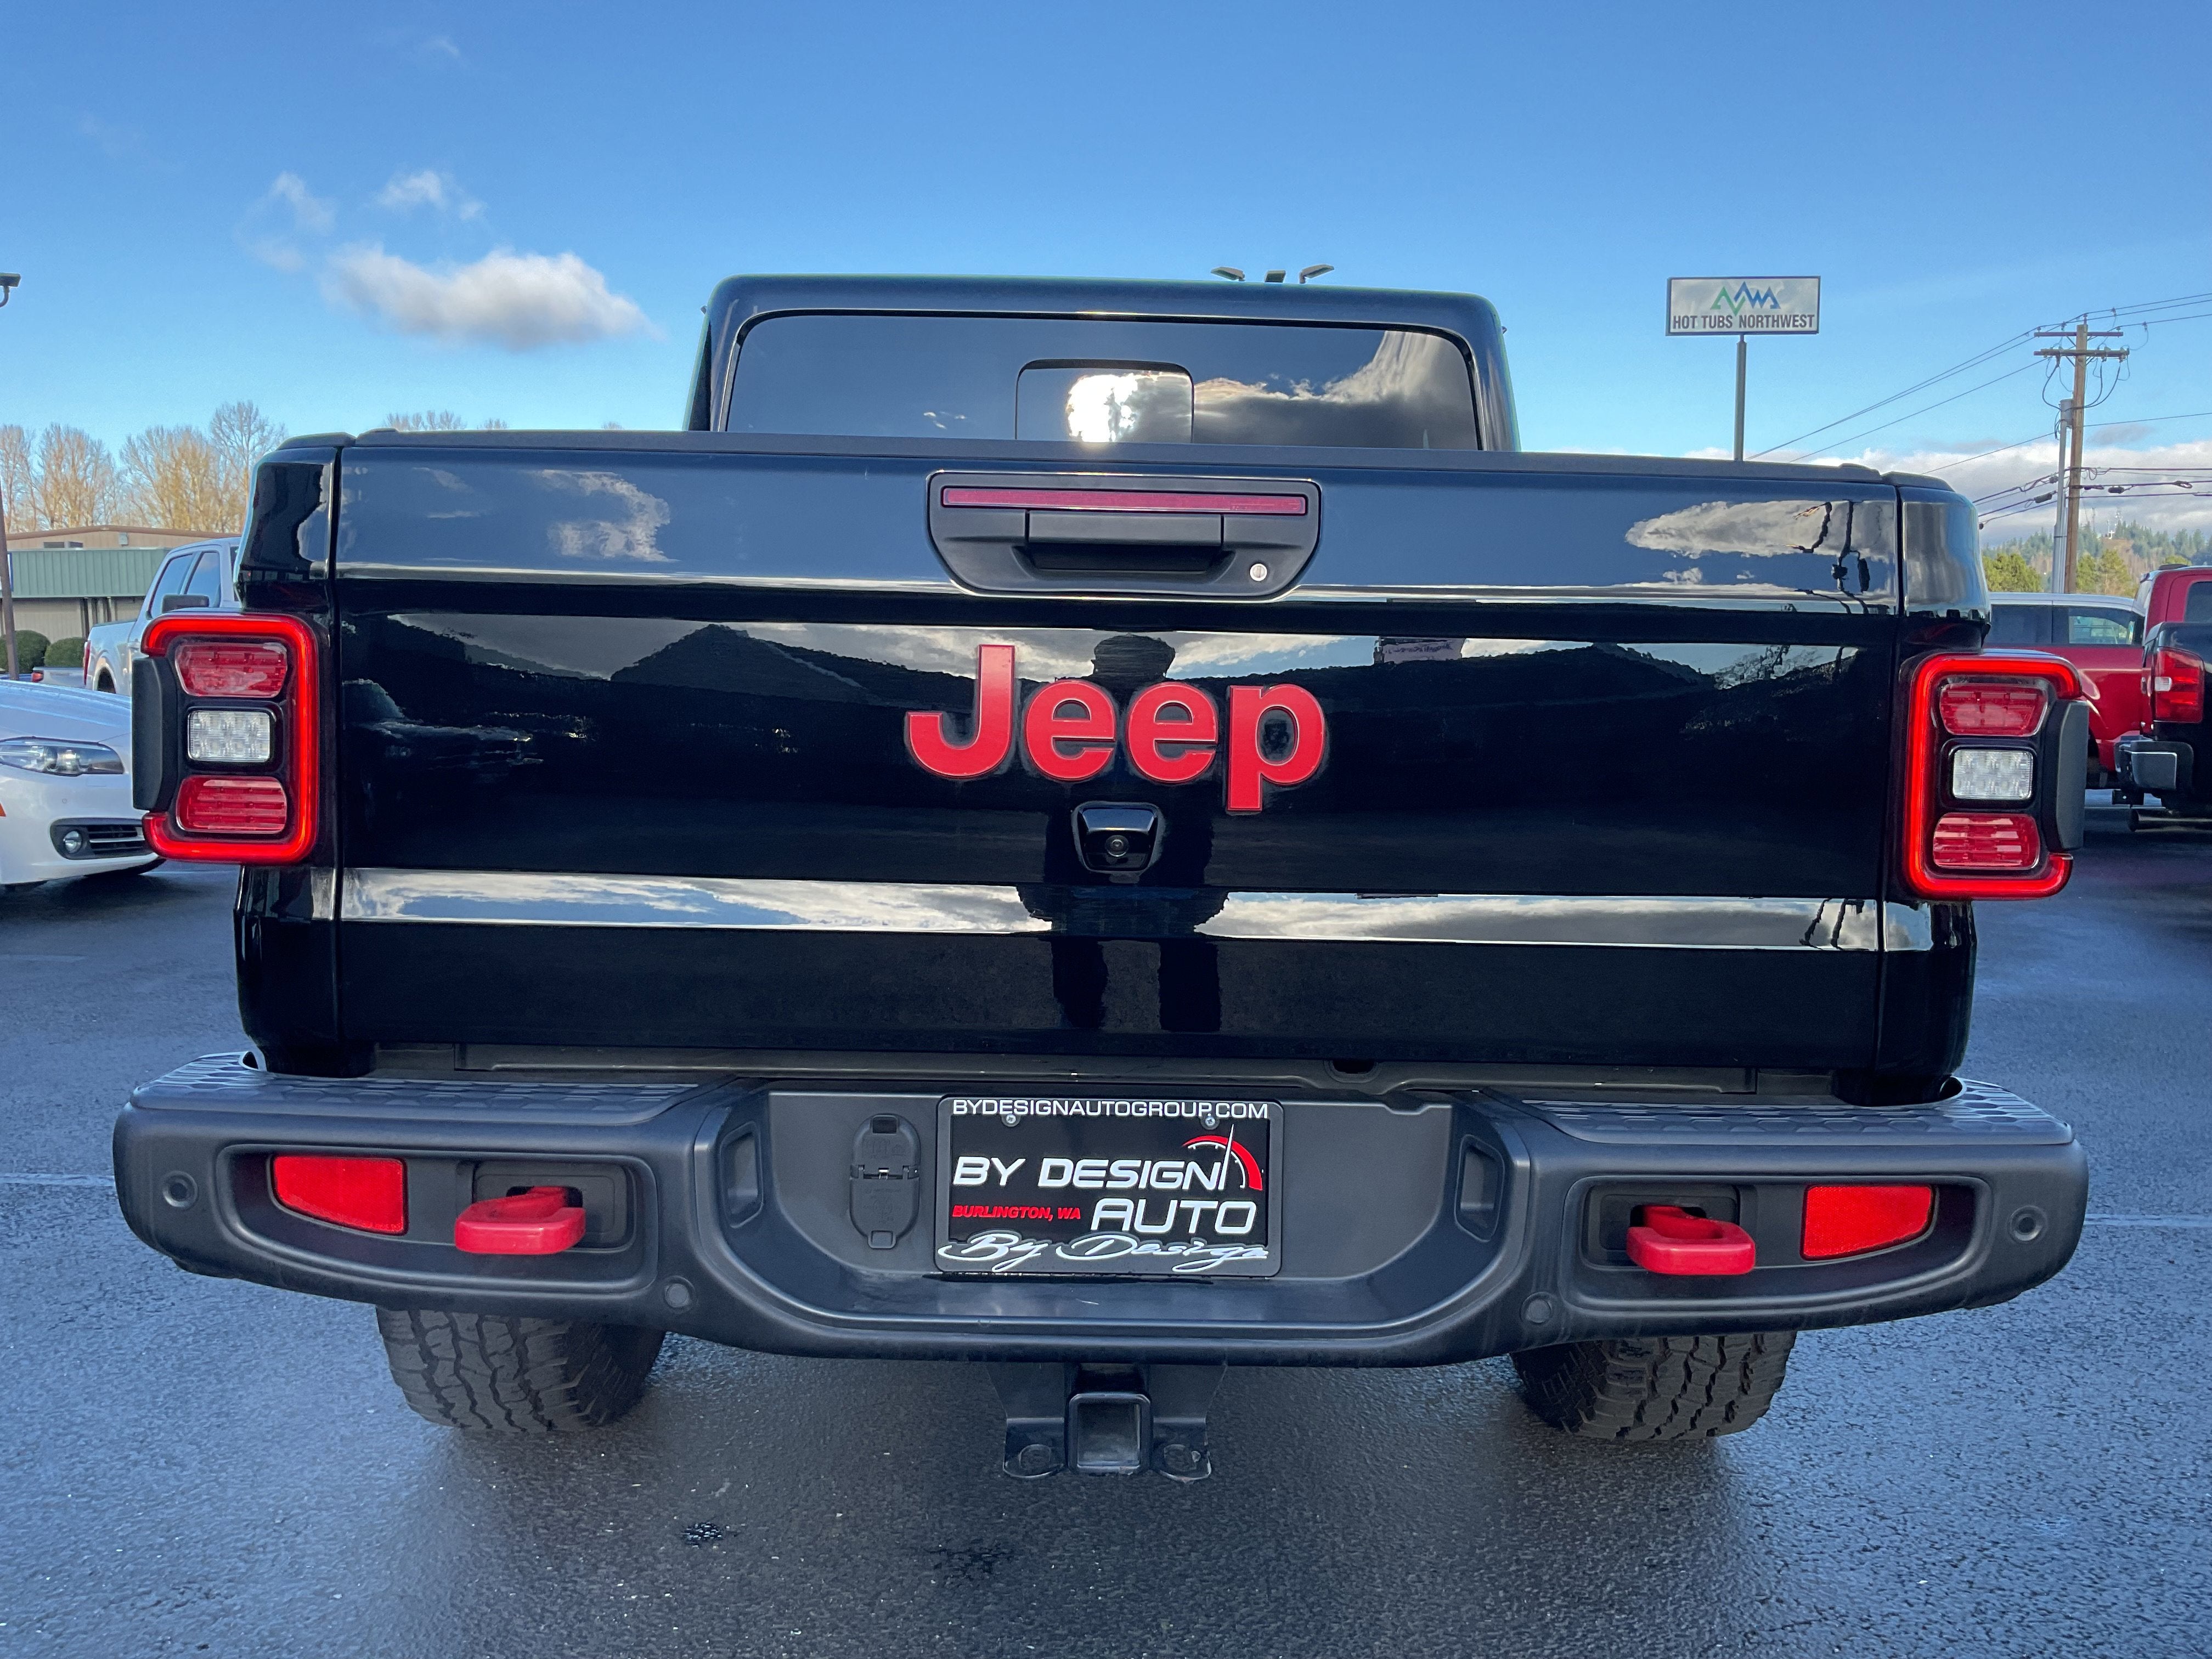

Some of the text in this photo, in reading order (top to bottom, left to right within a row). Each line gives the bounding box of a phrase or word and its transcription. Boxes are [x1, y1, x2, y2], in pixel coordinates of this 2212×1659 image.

[1673, 314, 1815, 329] HOT TUBS NORTHWEST
[906, 644, 1327, 812] Jeep
[952, 1099, 1268, 1119] BYDESIGNAUTOGROUP.COM
[953, 1156, 1222, 1190] BY DESIGN
[952, 1205, 1081, 1220] BURLINGTON, WA
[1090, 1198, 1256, 1234] AUTO
[937, 1233, 1269, 1273] By Design
